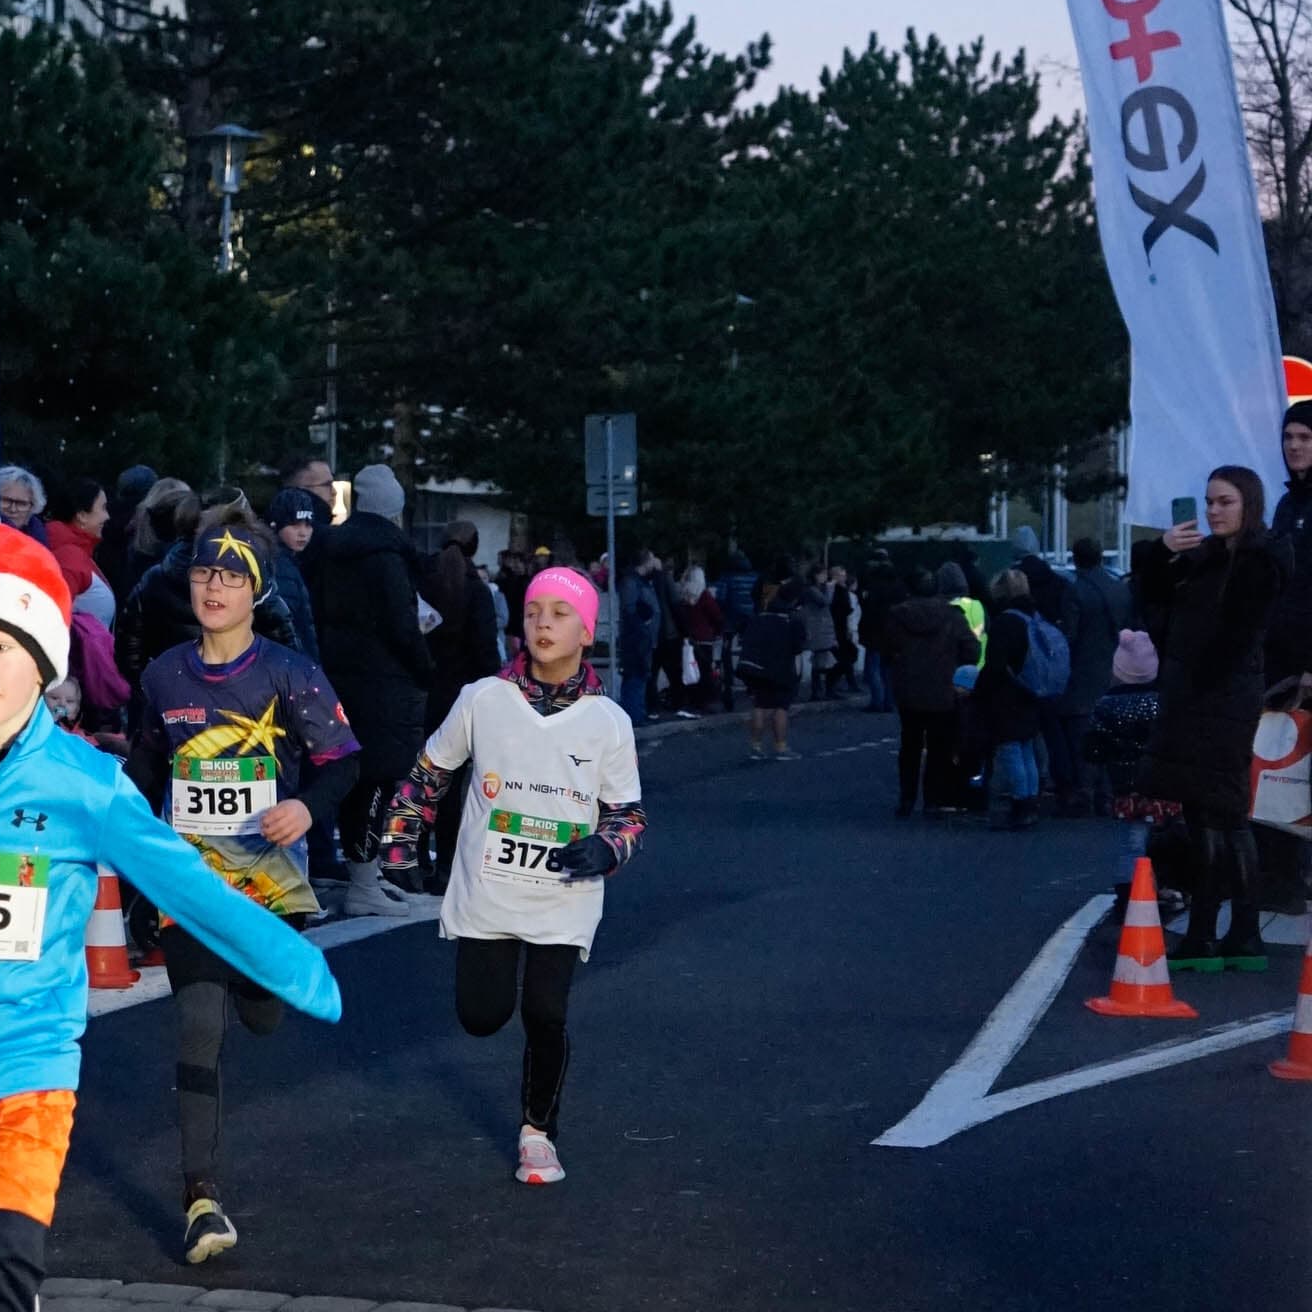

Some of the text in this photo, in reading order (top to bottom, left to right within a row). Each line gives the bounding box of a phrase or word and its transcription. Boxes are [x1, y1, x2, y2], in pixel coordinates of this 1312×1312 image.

[214, 761, 240, 770] KIDS
[505, 781, 523, 790] NN
[529, 783, 566, 797] NIGHT
[187, 786, 252, 815] 3181
[535, 819, 559, 831] KIDS
[497, 838, 564, 872] 3178
